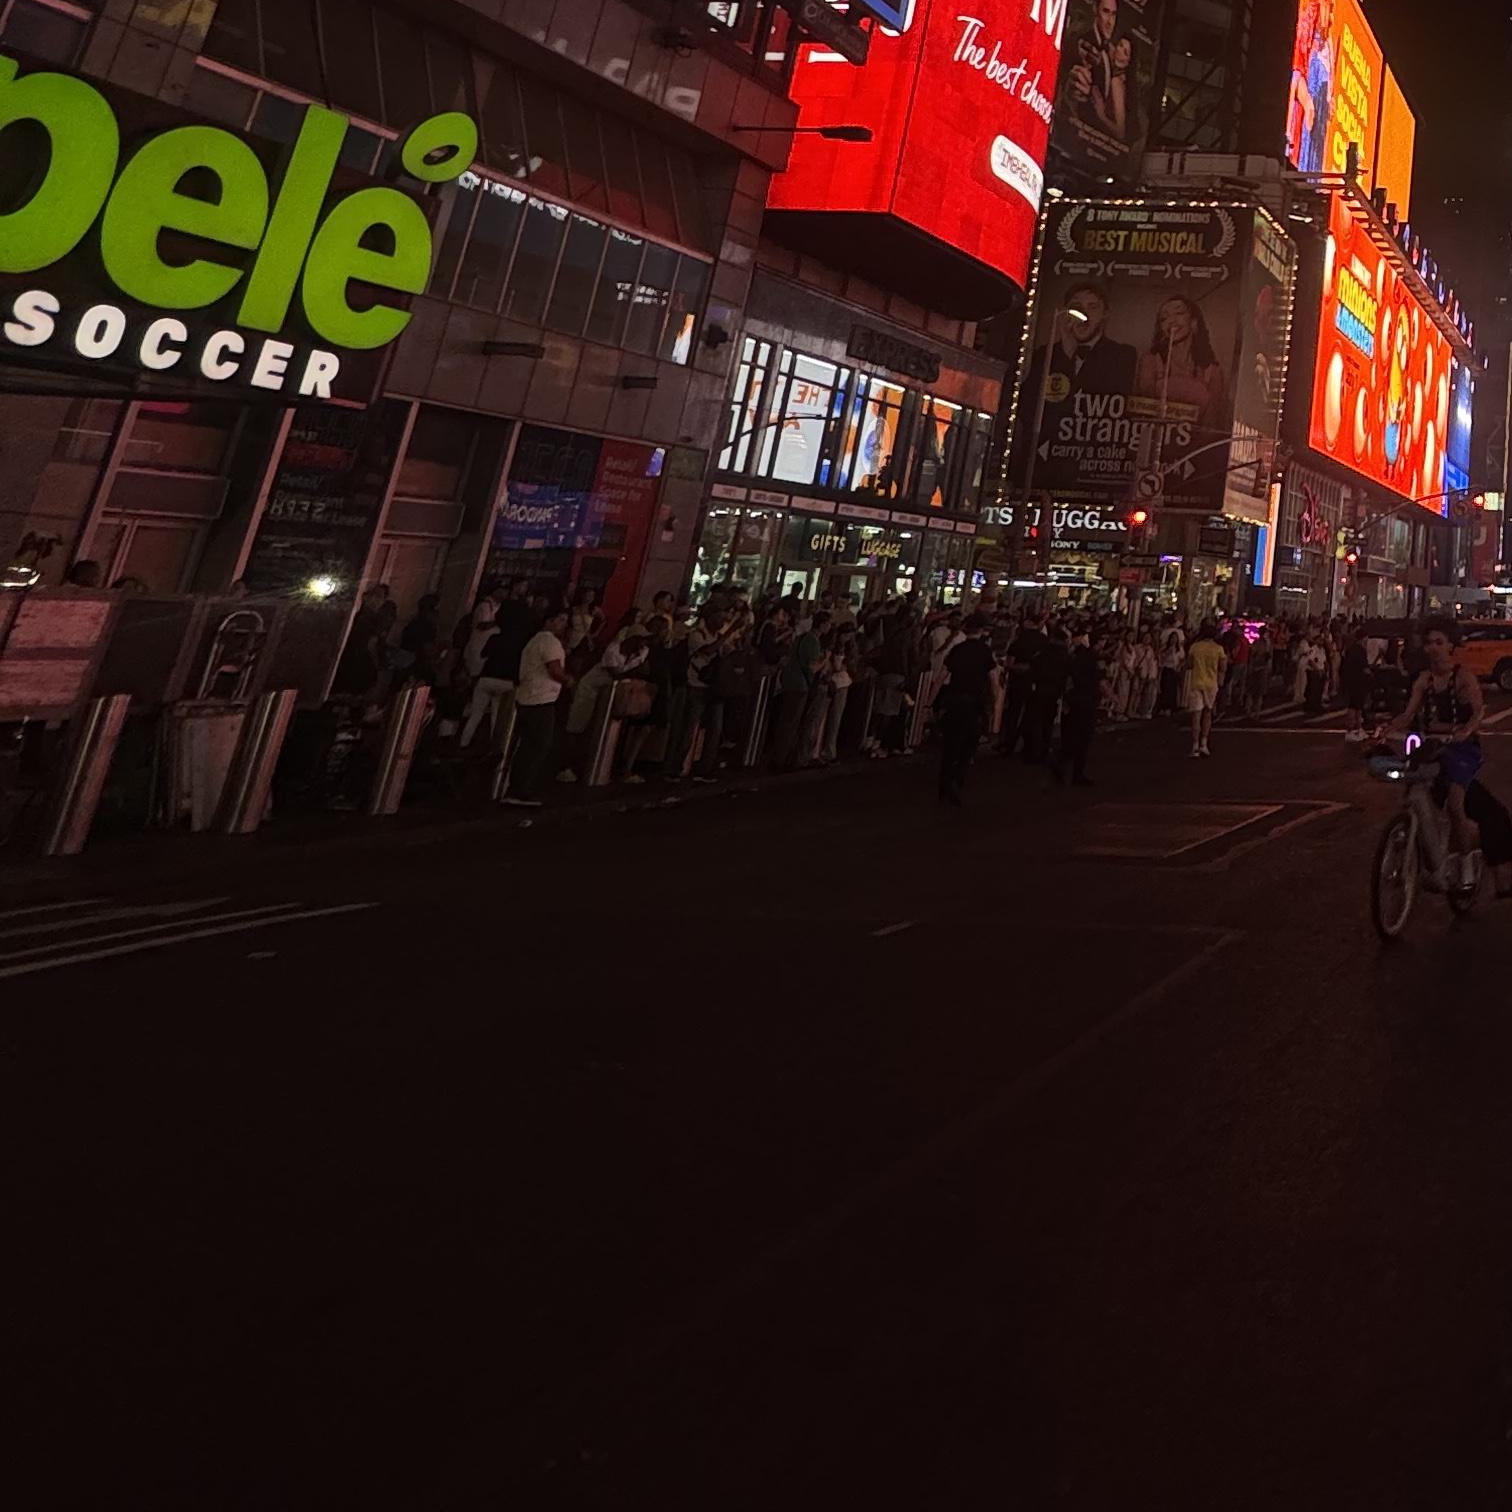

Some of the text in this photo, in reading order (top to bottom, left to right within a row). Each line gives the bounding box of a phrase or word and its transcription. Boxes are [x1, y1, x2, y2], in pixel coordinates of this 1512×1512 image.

[953, 15, 987, 71] The
[985, 40, 1028, 96] best
[1341, 22, 1372, 93] BUENA
[1340, 54, 1368, 128] VISTA
[1083, 228, 1206, 255] BEST MUSICAL
[3, 289, 341, 399] SOCCER
[1073, 388, 1126, 419] two
[1057, 415, 1193, 451] strangrs
[1051, 444, 1084, 461] carry
[1097, 444, 1127, 460] cake
[1079, 458, 1122, 473] across
[810, 533, 847, 553] GIFTS
